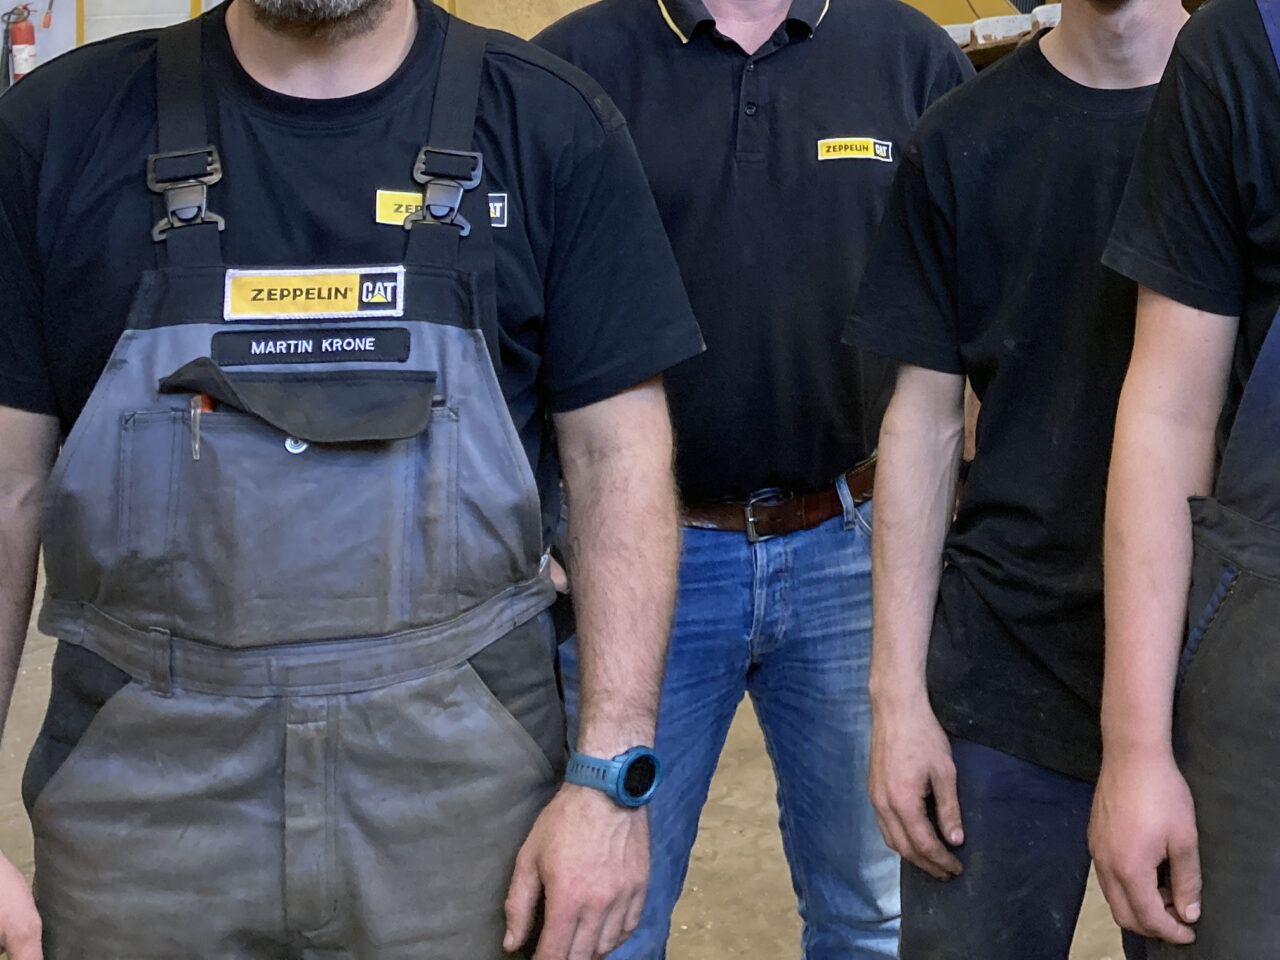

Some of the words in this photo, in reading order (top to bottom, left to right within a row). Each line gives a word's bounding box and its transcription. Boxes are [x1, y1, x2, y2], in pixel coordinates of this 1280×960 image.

[825, 144, 869, 153] ZEPPELIN
[875, 144, 888, 157] CAT
[251, 286, 349, 302] ZEPPELIN
[362, 281, 396, 304] CAT
[251, 339, 313, 355] MARTIN
[322, 337, 375, 352] KRONE
